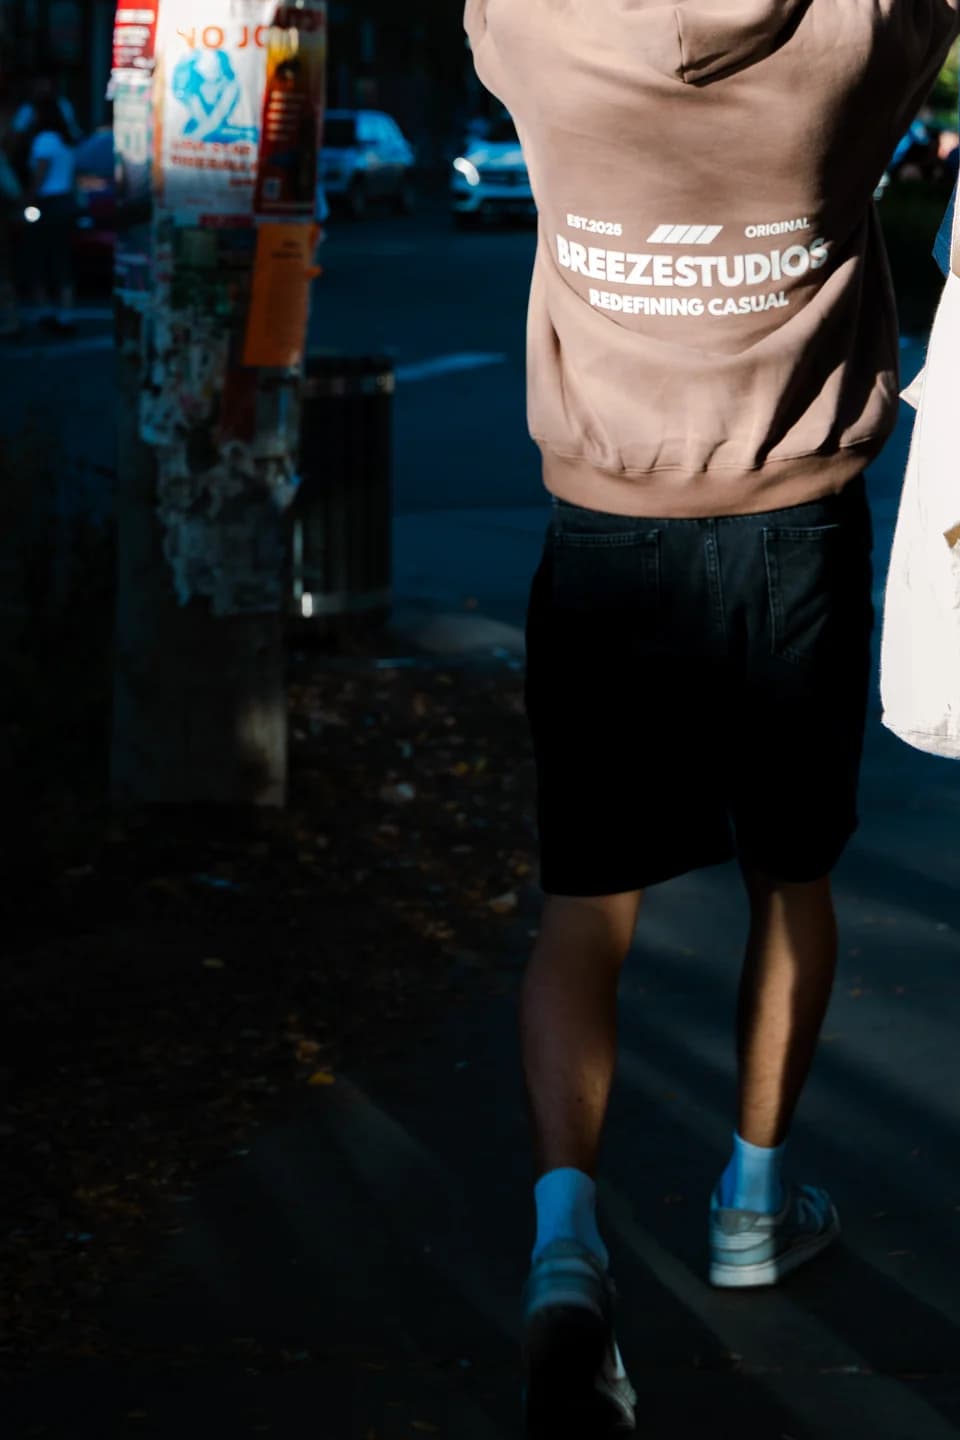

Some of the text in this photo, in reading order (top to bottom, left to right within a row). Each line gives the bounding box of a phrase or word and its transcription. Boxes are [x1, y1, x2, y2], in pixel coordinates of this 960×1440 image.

[566, 213, 623, 236] EST.2025
[744, 217, 810, 238] ORIGINAL
[556, 233, 828, 287] BREEZESTUDIOS
[589, 288, 789, 316] REDEFINING CASUAL
